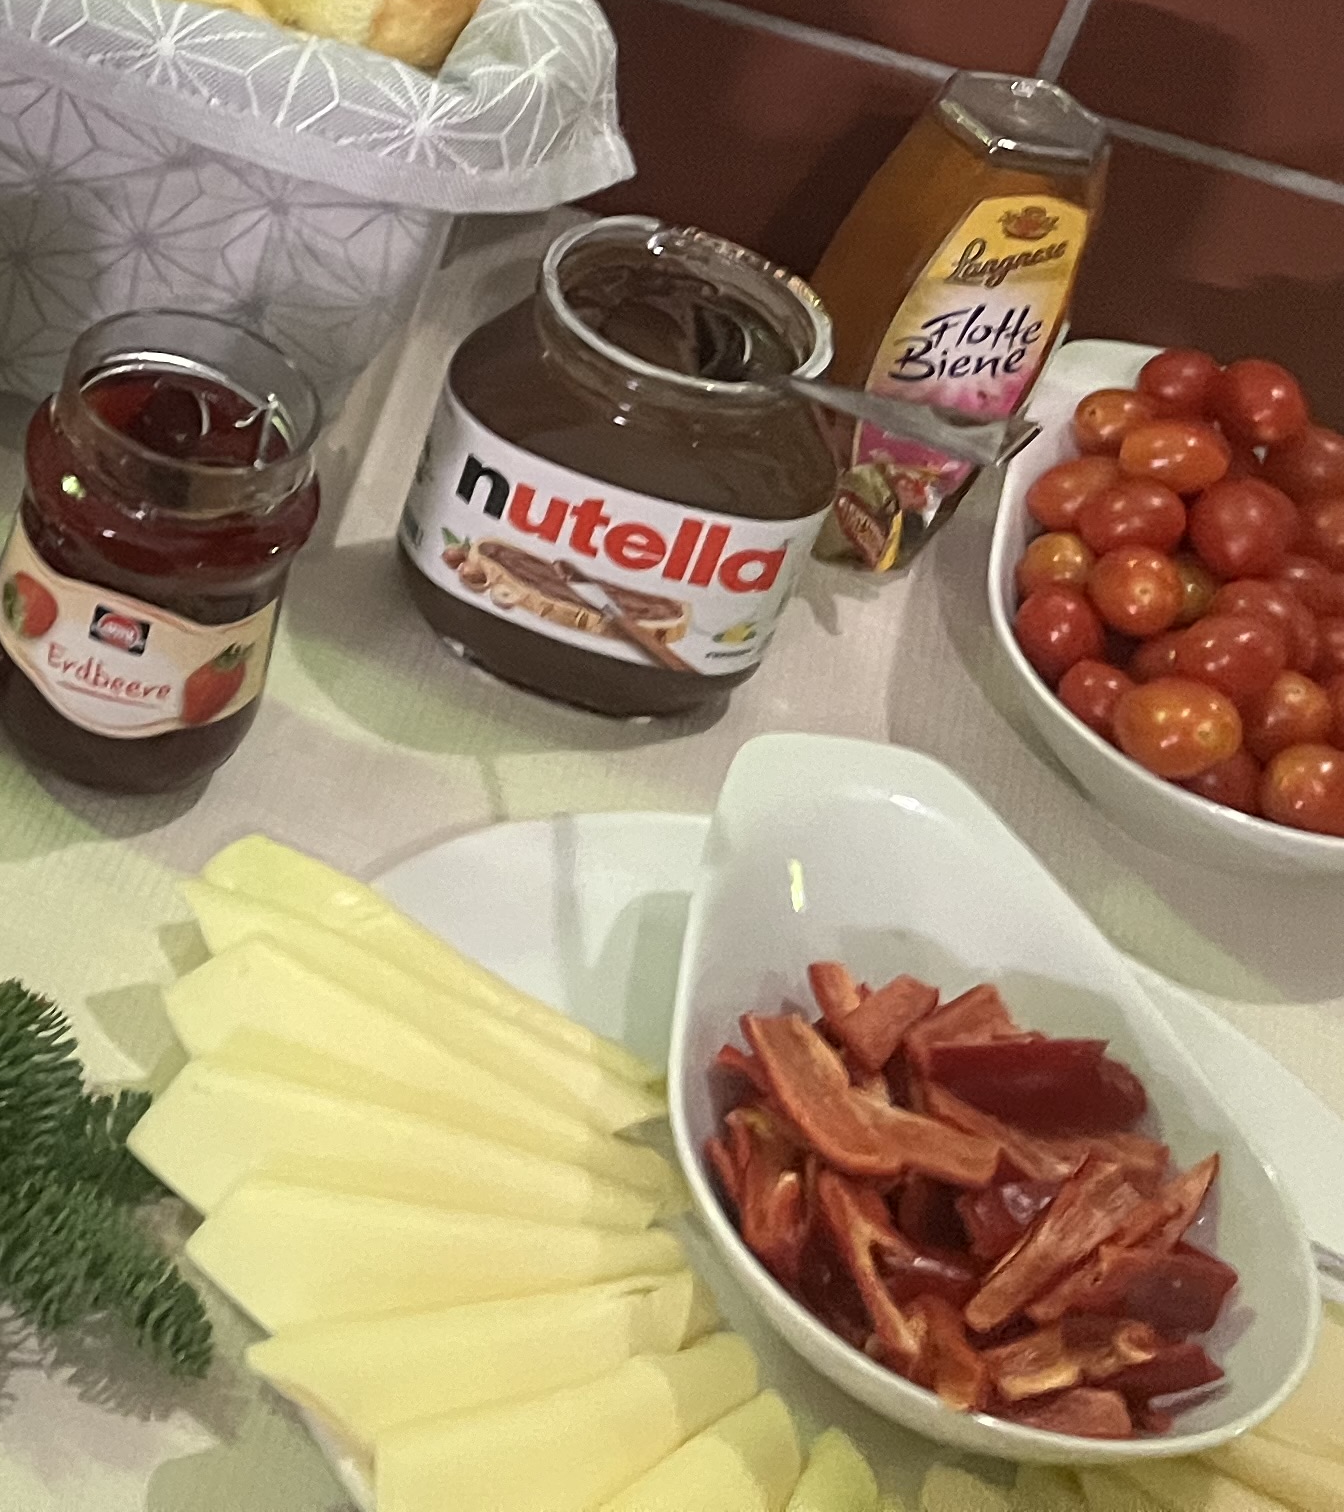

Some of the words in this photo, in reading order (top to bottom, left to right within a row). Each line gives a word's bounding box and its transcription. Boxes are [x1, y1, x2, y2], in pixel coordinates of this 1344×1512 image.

[945, 238, 1068, 288] Langnese
[921, 304, 1044, 350] Flotte
[888, 336, 1026, 382] Biene
[454, 454, 790, 594] nutella
[45, 641, 174, 702] Erdbeere
